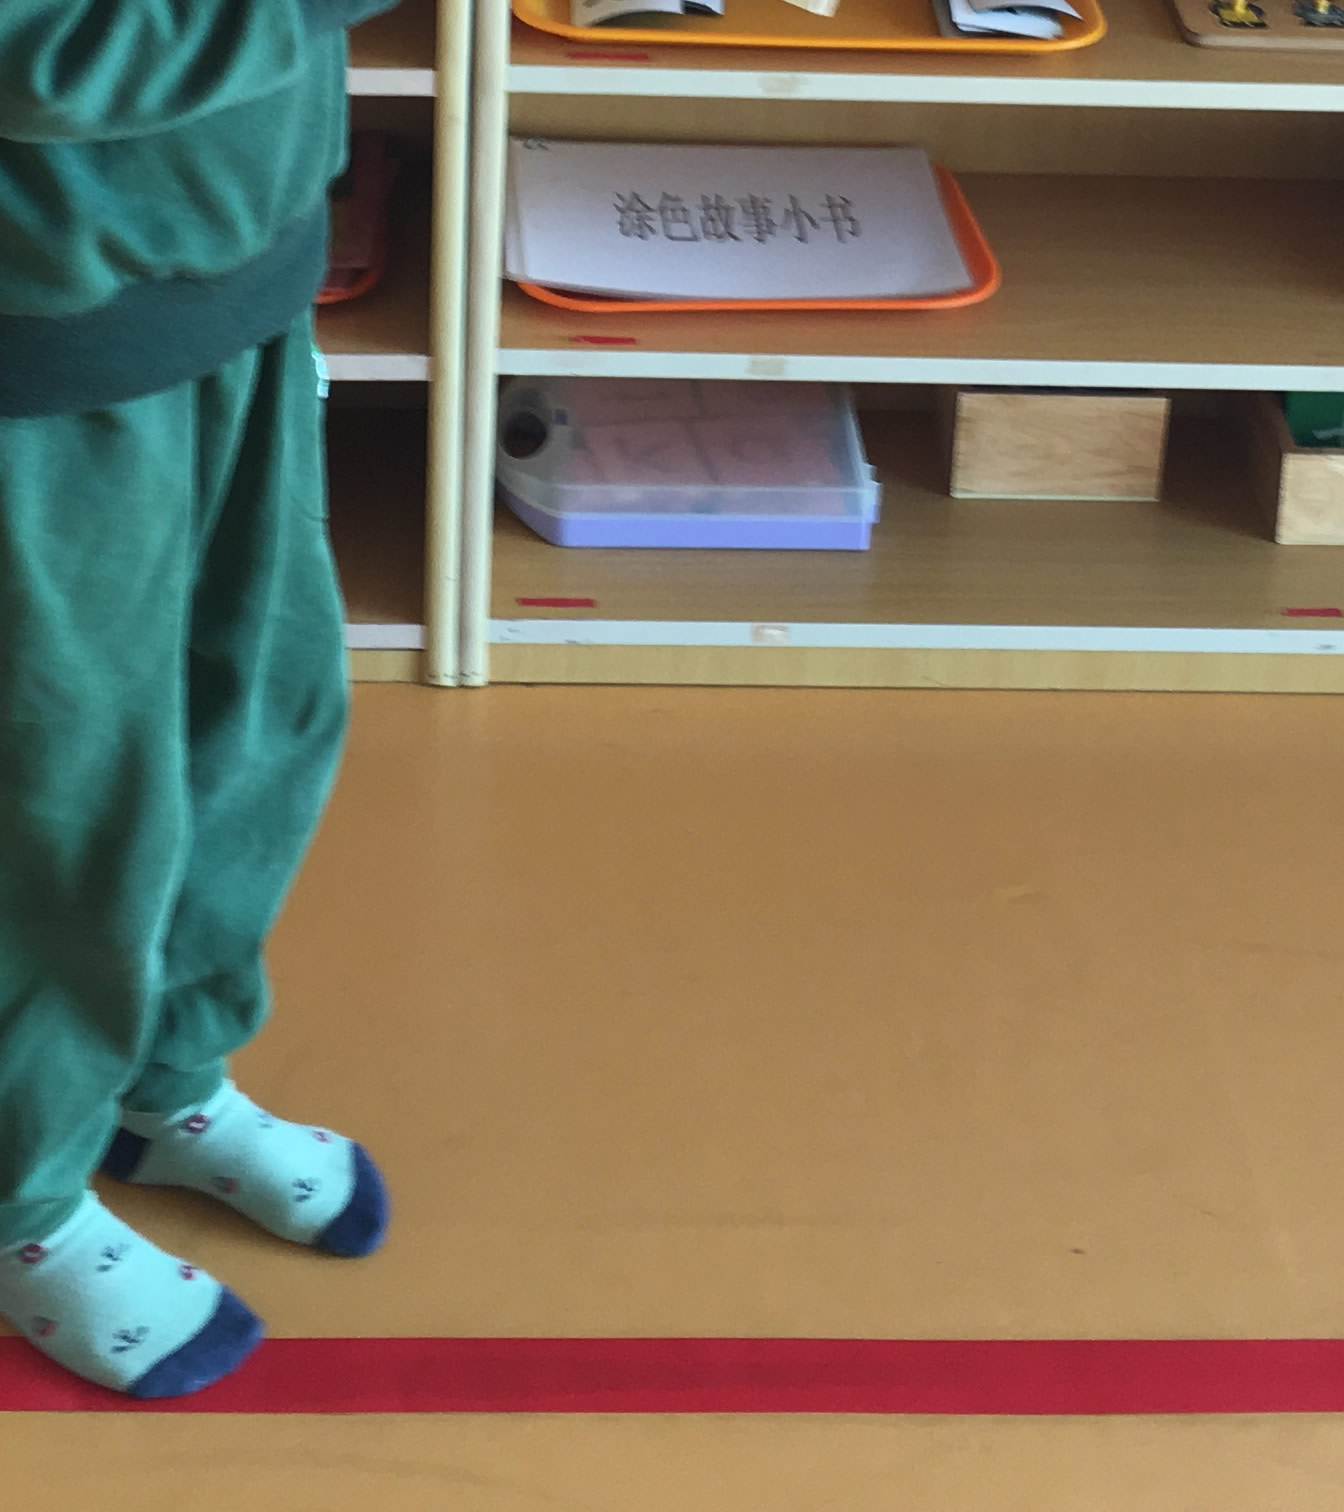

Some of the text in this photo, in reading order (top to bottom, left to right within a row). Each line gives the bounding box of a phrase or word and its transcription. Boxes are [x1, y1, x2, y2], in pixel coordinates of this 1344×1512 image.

[613, 189, 862, 245] 涂色故事小书
